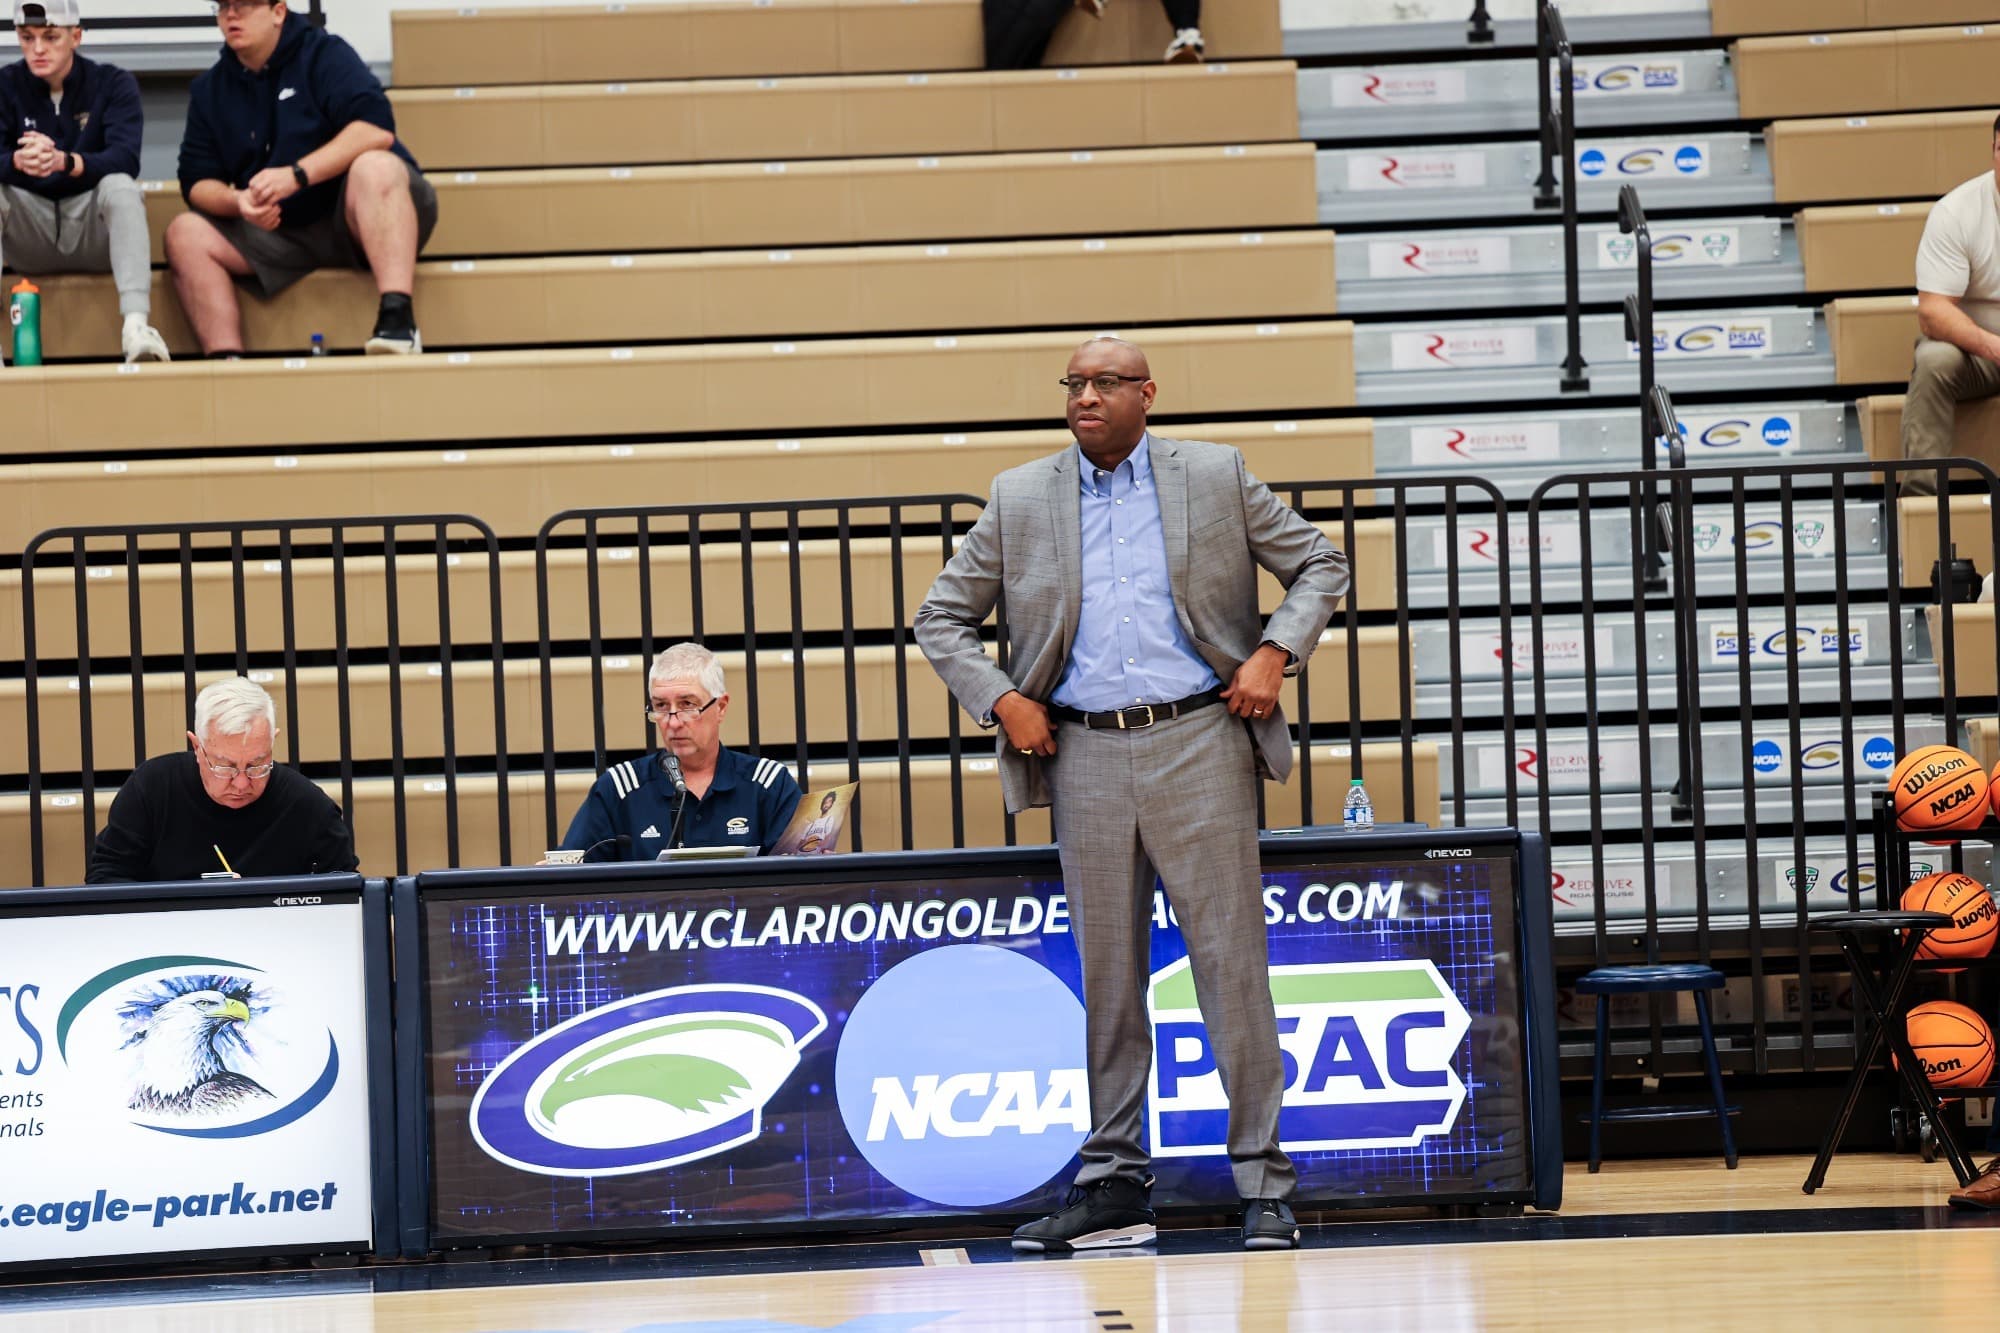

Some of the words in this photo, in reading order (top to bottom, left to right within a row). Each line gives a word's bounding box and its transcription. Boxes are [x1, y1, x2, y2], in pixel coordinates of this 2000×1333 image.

[1716, 637, 1756, 649] PSC
[1821, 634, 1862, 647] PSC
[1569, 755, 1604, 766] RIVR
[1753, 753, 1783, 765] NCAA
[1866, 752, 1894, 763] NCAA
[1903, 758, 1967, 795] Wilson
[1930, 783, 1976, 816] NCAA
[1432, 848, 1472, 858] NEVCO
[1603, 879, 1633, 890] IVER
[1786, 873, 1819, 885] MC
[281, 896, 322, 906] NEVCO
[1569, 891, 1635, 899] ROAOUSE
[545, 880, 1404, 955] WWW.CLARIONGOLDEAS.COM
[1155, 1010, 1450, 1099] PAC
[1917, 1057, 1963, 1075] lson
[0, 1090, 44, 1109] ents
[866, 1067, 1093, 1141] NCAA
[0, 1117, 45, 1138] nals
[0, 1182, 338, 1232] .eagle-park.net
